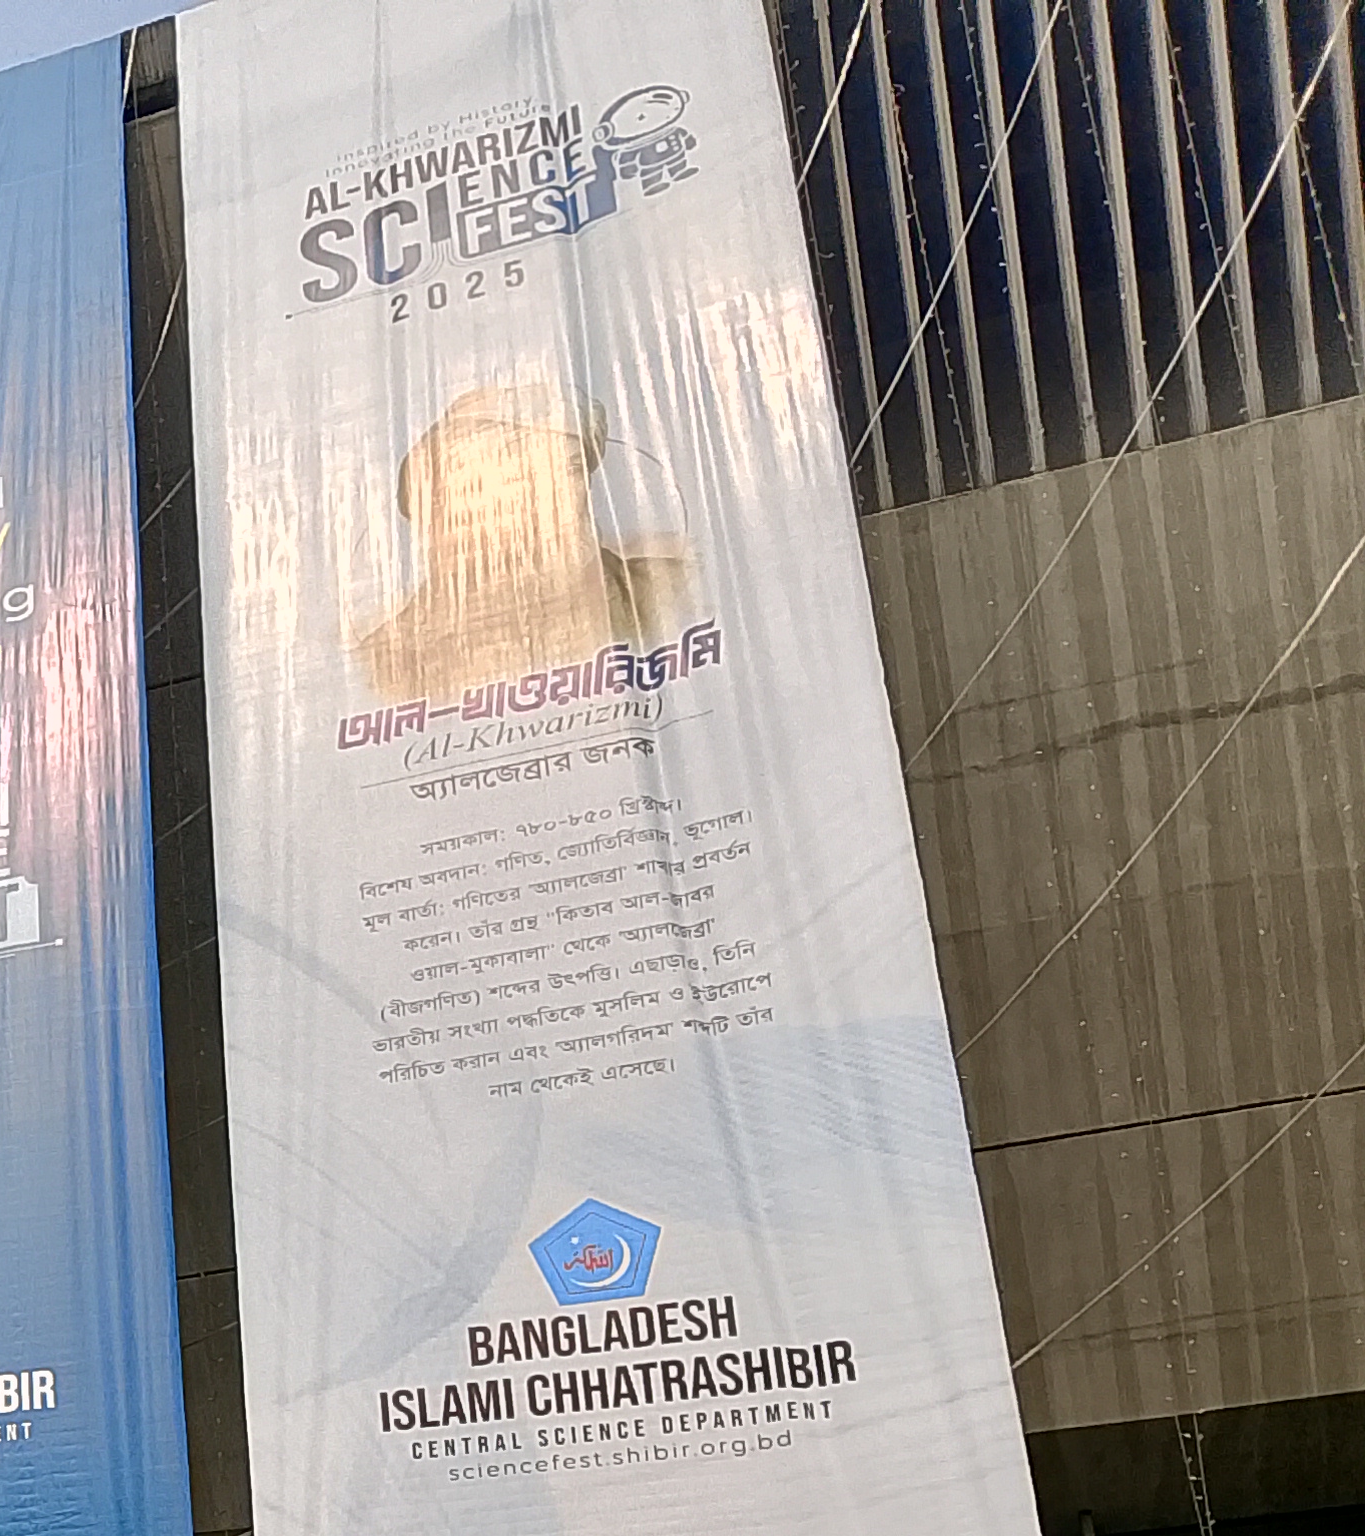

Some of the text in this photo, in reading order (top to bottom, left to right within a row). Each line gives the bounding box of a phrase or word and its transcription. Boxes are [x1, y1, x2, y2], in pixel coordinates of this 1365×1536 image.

[304, 104, 581, 220] AL-KHWARIZMI
[462, 178, 595, 257] FEST
[391, 260, 525, 323] 2025
[404, 696, 663, 772] (Al-Khwarizmi)
[410, 735, 656, 801] অ্যালজেব্রার জনক
[516, 808, 612, 837] ৭৮০-৮৫০
[495, 851, 551, 872] গণিত,
[362, 912, 392, 933] মূল
[452, 887, 521, 911] গণিতের
[563, 934, 611, 955] থেকে
[713, 939, 755, 966] তিনি
[372, 1027, 440, 1052] ভারতীয়
[447, 1019, 498, 1039] সংখ্যা
[591, 990, 661, 1017] মুসলিম
[669, 987, 684, 1000] ও
[379, 1060, 445, 1083] পরিচিত
[451, 1051, 501, 1071] করান
[508, 1045, 549, 1061] এবং
[488, 1081, 522, 1098] নাম
[531, 1067, 594, 1093] থেকেই
[468, 1295, 738, 1368] BANGLADESH
[379, 1339, 858, 1433] ISLAMI CHHATRASHIBIR
[411, 1400, 833, 1460] CENTRAL SCIENCE DEPARTMENT
[448, 1429, 794, 1482] sciencefest.shibir.org.bd
